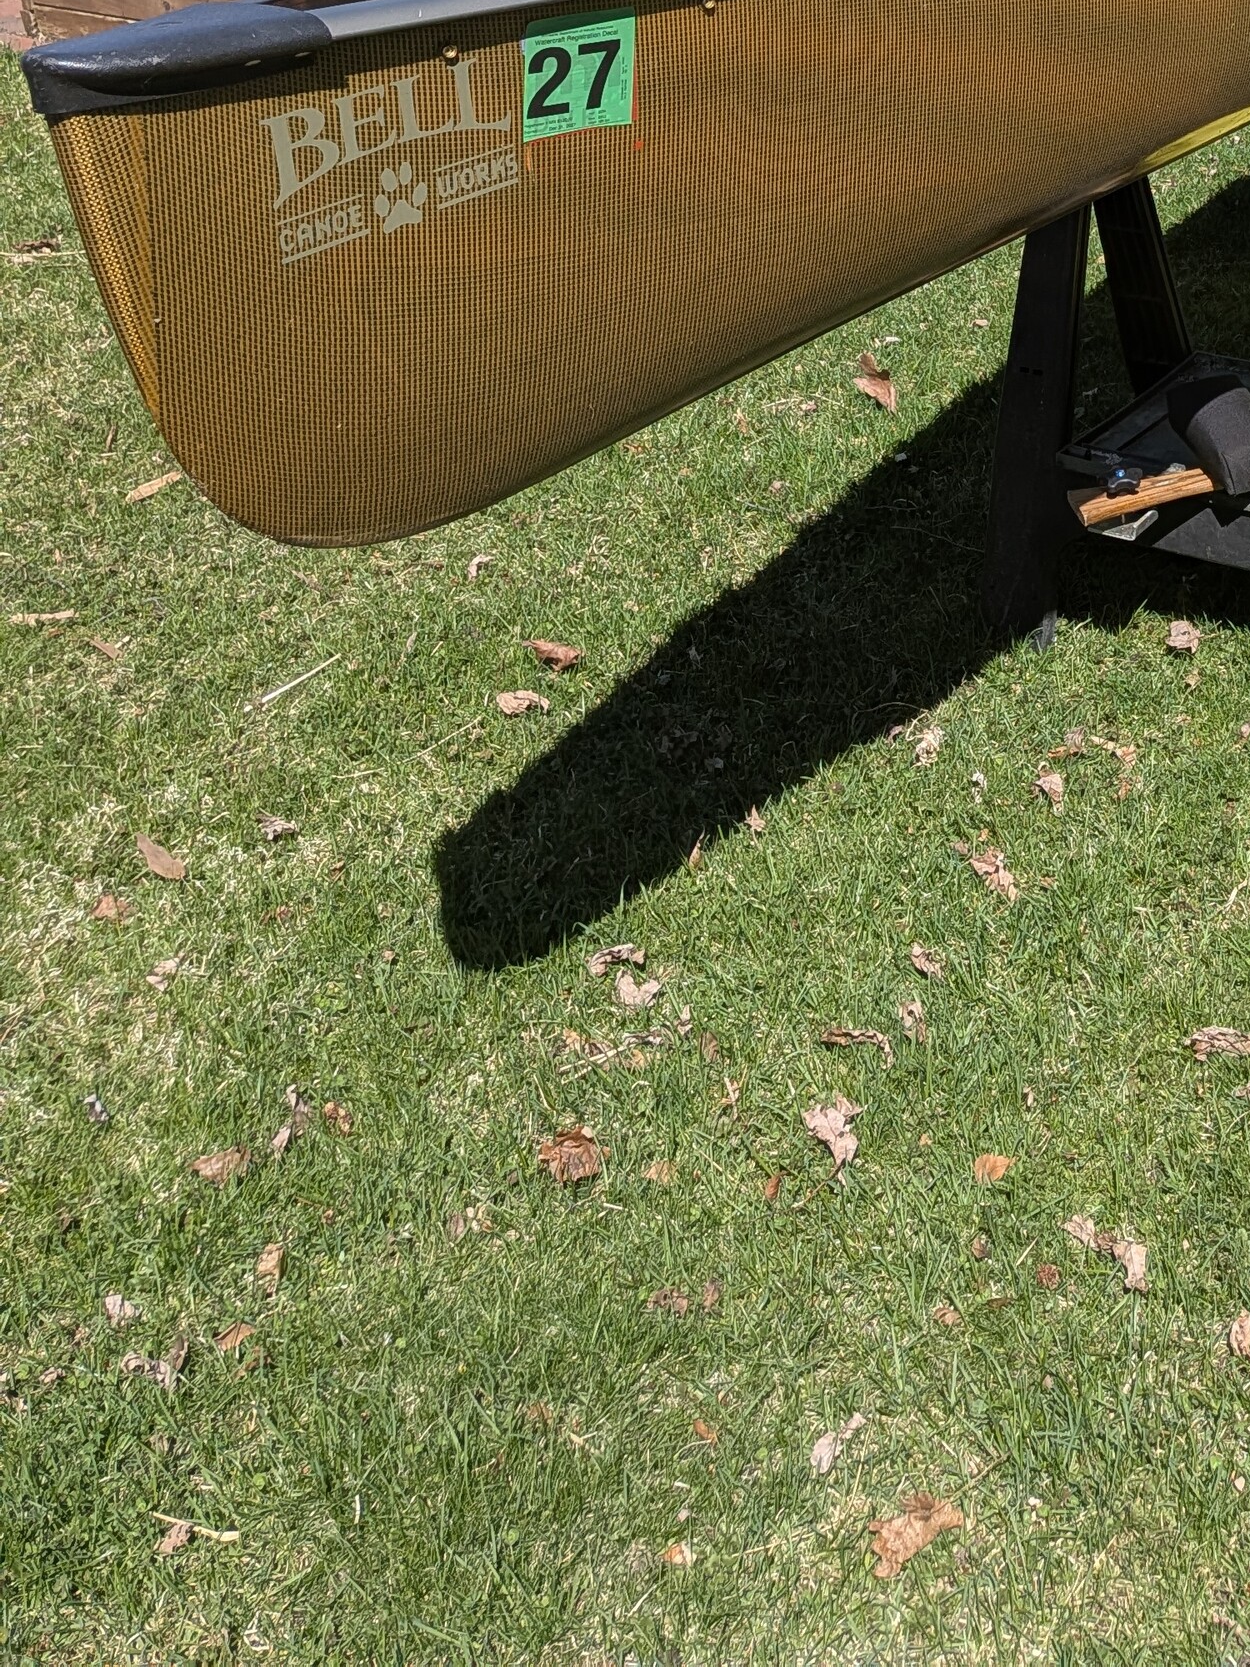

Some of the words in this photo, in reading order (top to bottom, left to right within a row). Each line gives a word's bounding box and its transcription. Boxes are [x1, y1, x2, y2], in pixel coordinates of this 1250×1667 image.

[527, 39, 621, 120] 27
[534, 36, 565, 46] Watercraft
[567, 32, 600, 43] Registration
[602, 29, 619, 37] Decal
[260, 58, 512, 210] BELL
[279, 204, 363, 253] CANOE
[436, 153, 519, 198] WORKS
